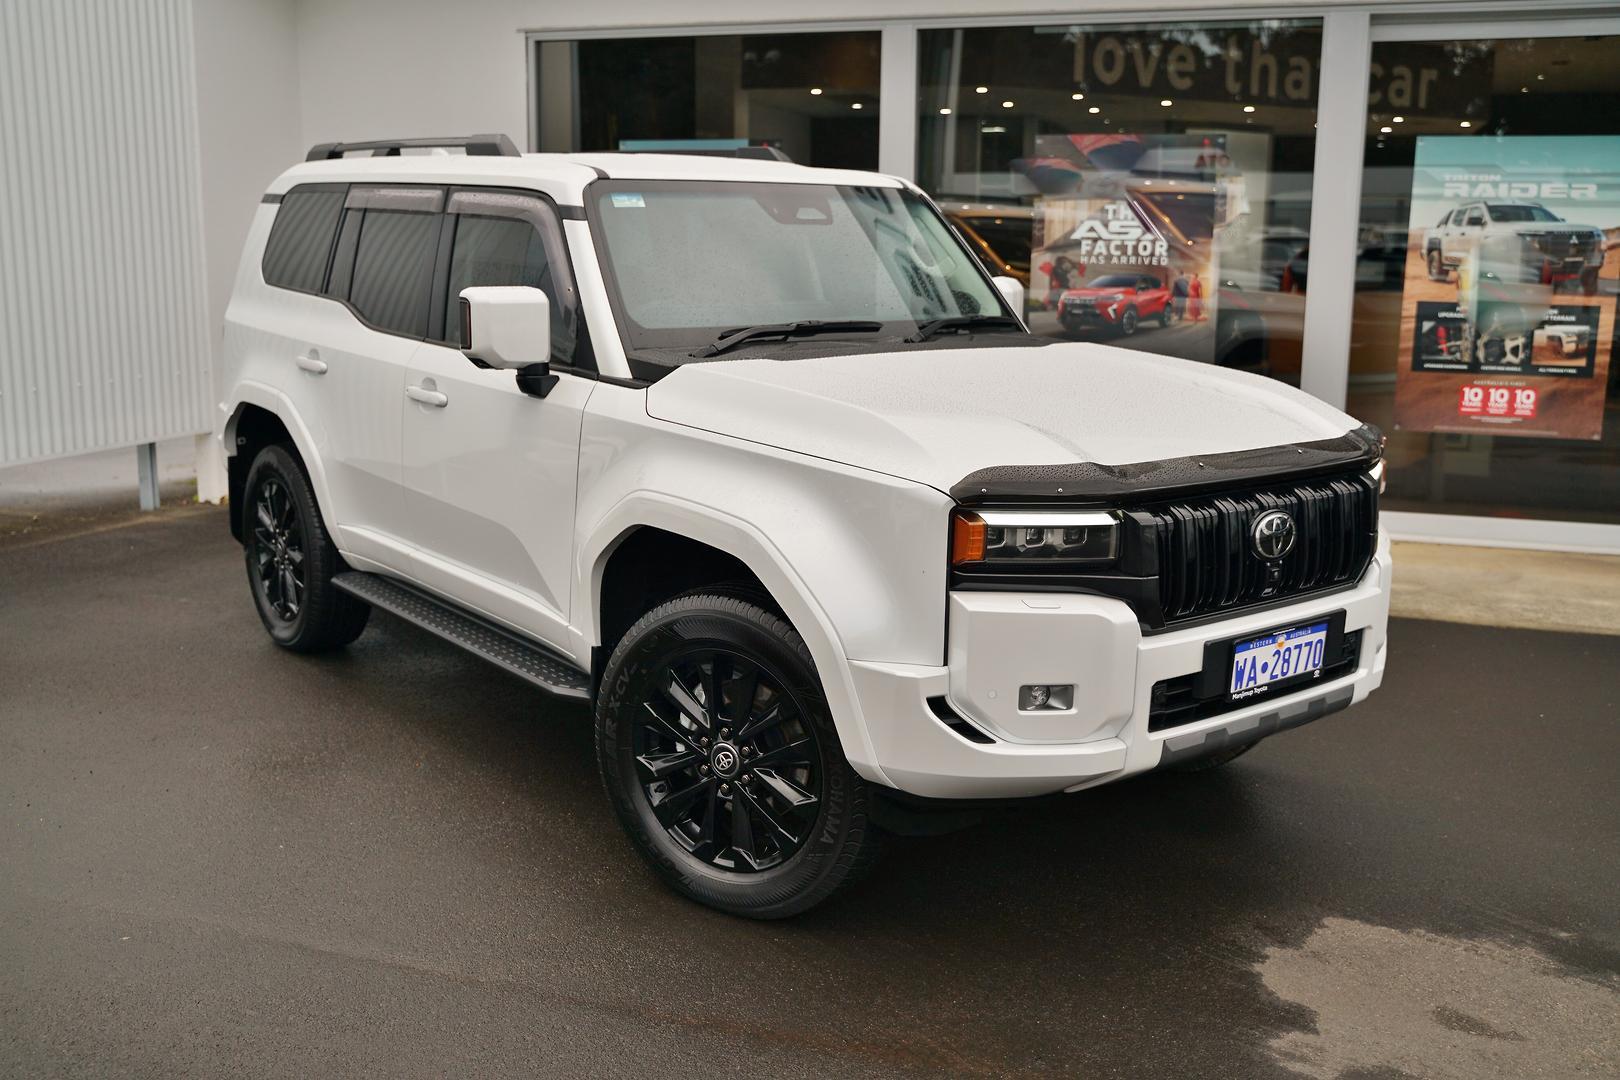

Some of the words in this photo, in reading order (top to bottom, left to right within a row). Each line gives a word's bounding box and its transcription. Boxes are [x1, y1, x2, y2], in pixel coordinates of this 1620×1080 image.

[1072, 33, 1197, 90] love
[1223, 35, 1321, 100] tha
[1443, 182, 1599, 200] RAIDER
[1104, 204, 1136, 220] TH
[1080, 240, 1169, 256] FACTOR
[1080, 256, 1106, 265] HAS
[1112, 256, 1169, 266] ARRIVED
[1462, 386, 1483, 402] 10
[1488, 388, 1509, 403] 10
[1514, 389, 1536, 404] 10
[1249, 640, 1273, 649] WESTERN
[1290, 629, 1311, 638] AUSTRALIA
[1232, 690, 1253, 700] Manjimup
[1253, 686, 1268, 694] Toyota
